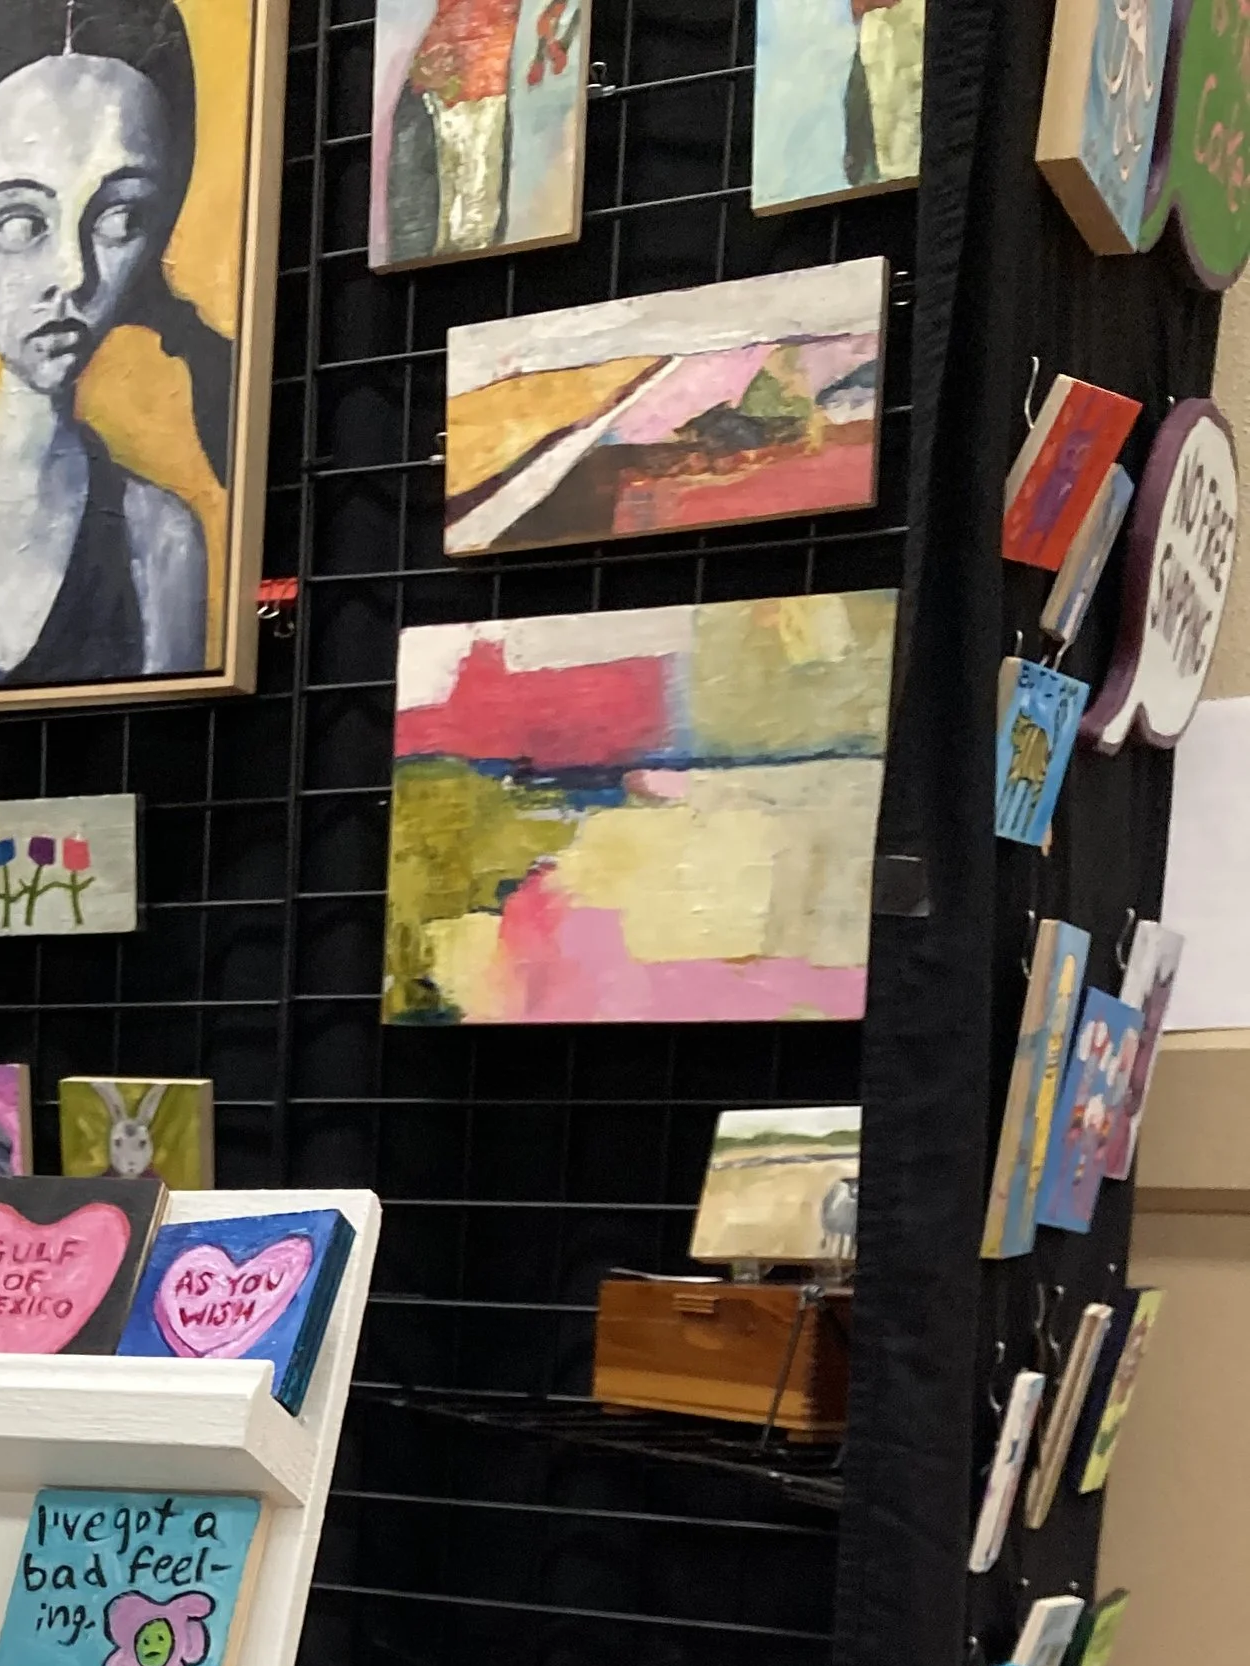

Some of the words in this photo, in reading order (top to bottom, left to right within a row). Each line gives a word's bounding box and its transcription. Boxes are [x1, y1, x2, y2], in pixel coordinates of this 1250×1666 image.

[3, 1270, 51, 1296] OF
[175, 1270, 214, 1297] AS
[227, 1268, 286, 1297] YOU
[179, 1299, 256, 1328] WISH
[38, 1505, 105, 1547] I've
[114, 1498, 181, 1555] got
[194, 1511, 219, 1540] a
[24, 1553, 107, 1592] bad
[128, 1545, 233, 1587] feel-
